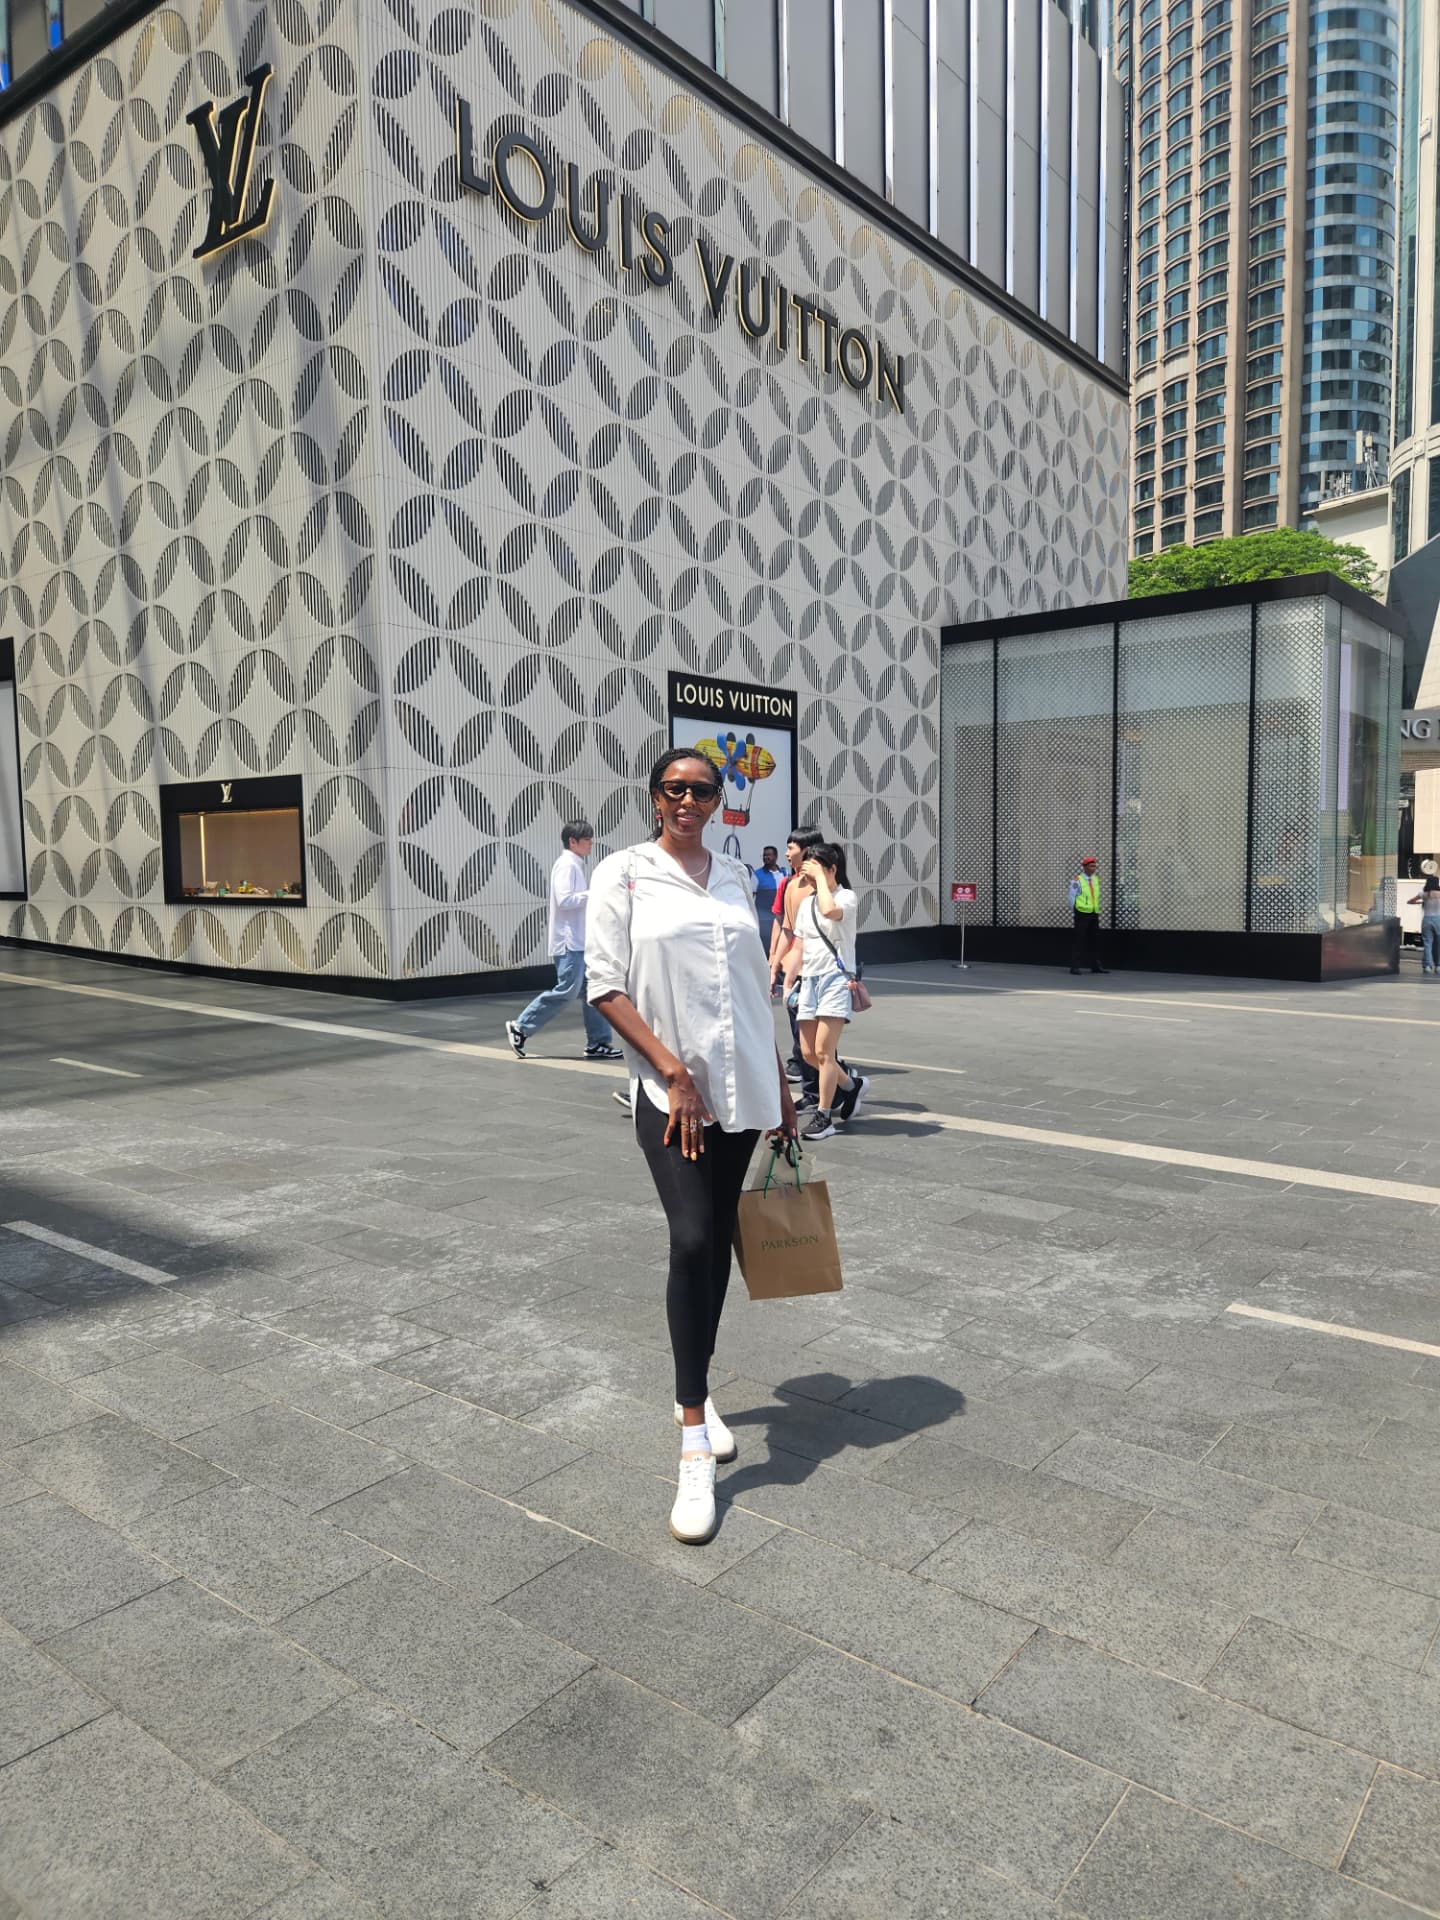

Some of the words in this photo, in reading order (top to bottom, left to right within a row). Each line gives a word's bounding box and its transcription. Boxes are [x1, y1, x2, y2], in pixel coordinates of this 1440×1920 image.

[455, 97, 674, 287] LOUIS
[695, 237, 904, 415] VUITTON
[676, 682, 724, 709] LOUIS
[729, 690, 792, 718] VUITTON
[761, 1234, 818, 1250] PARKSON
